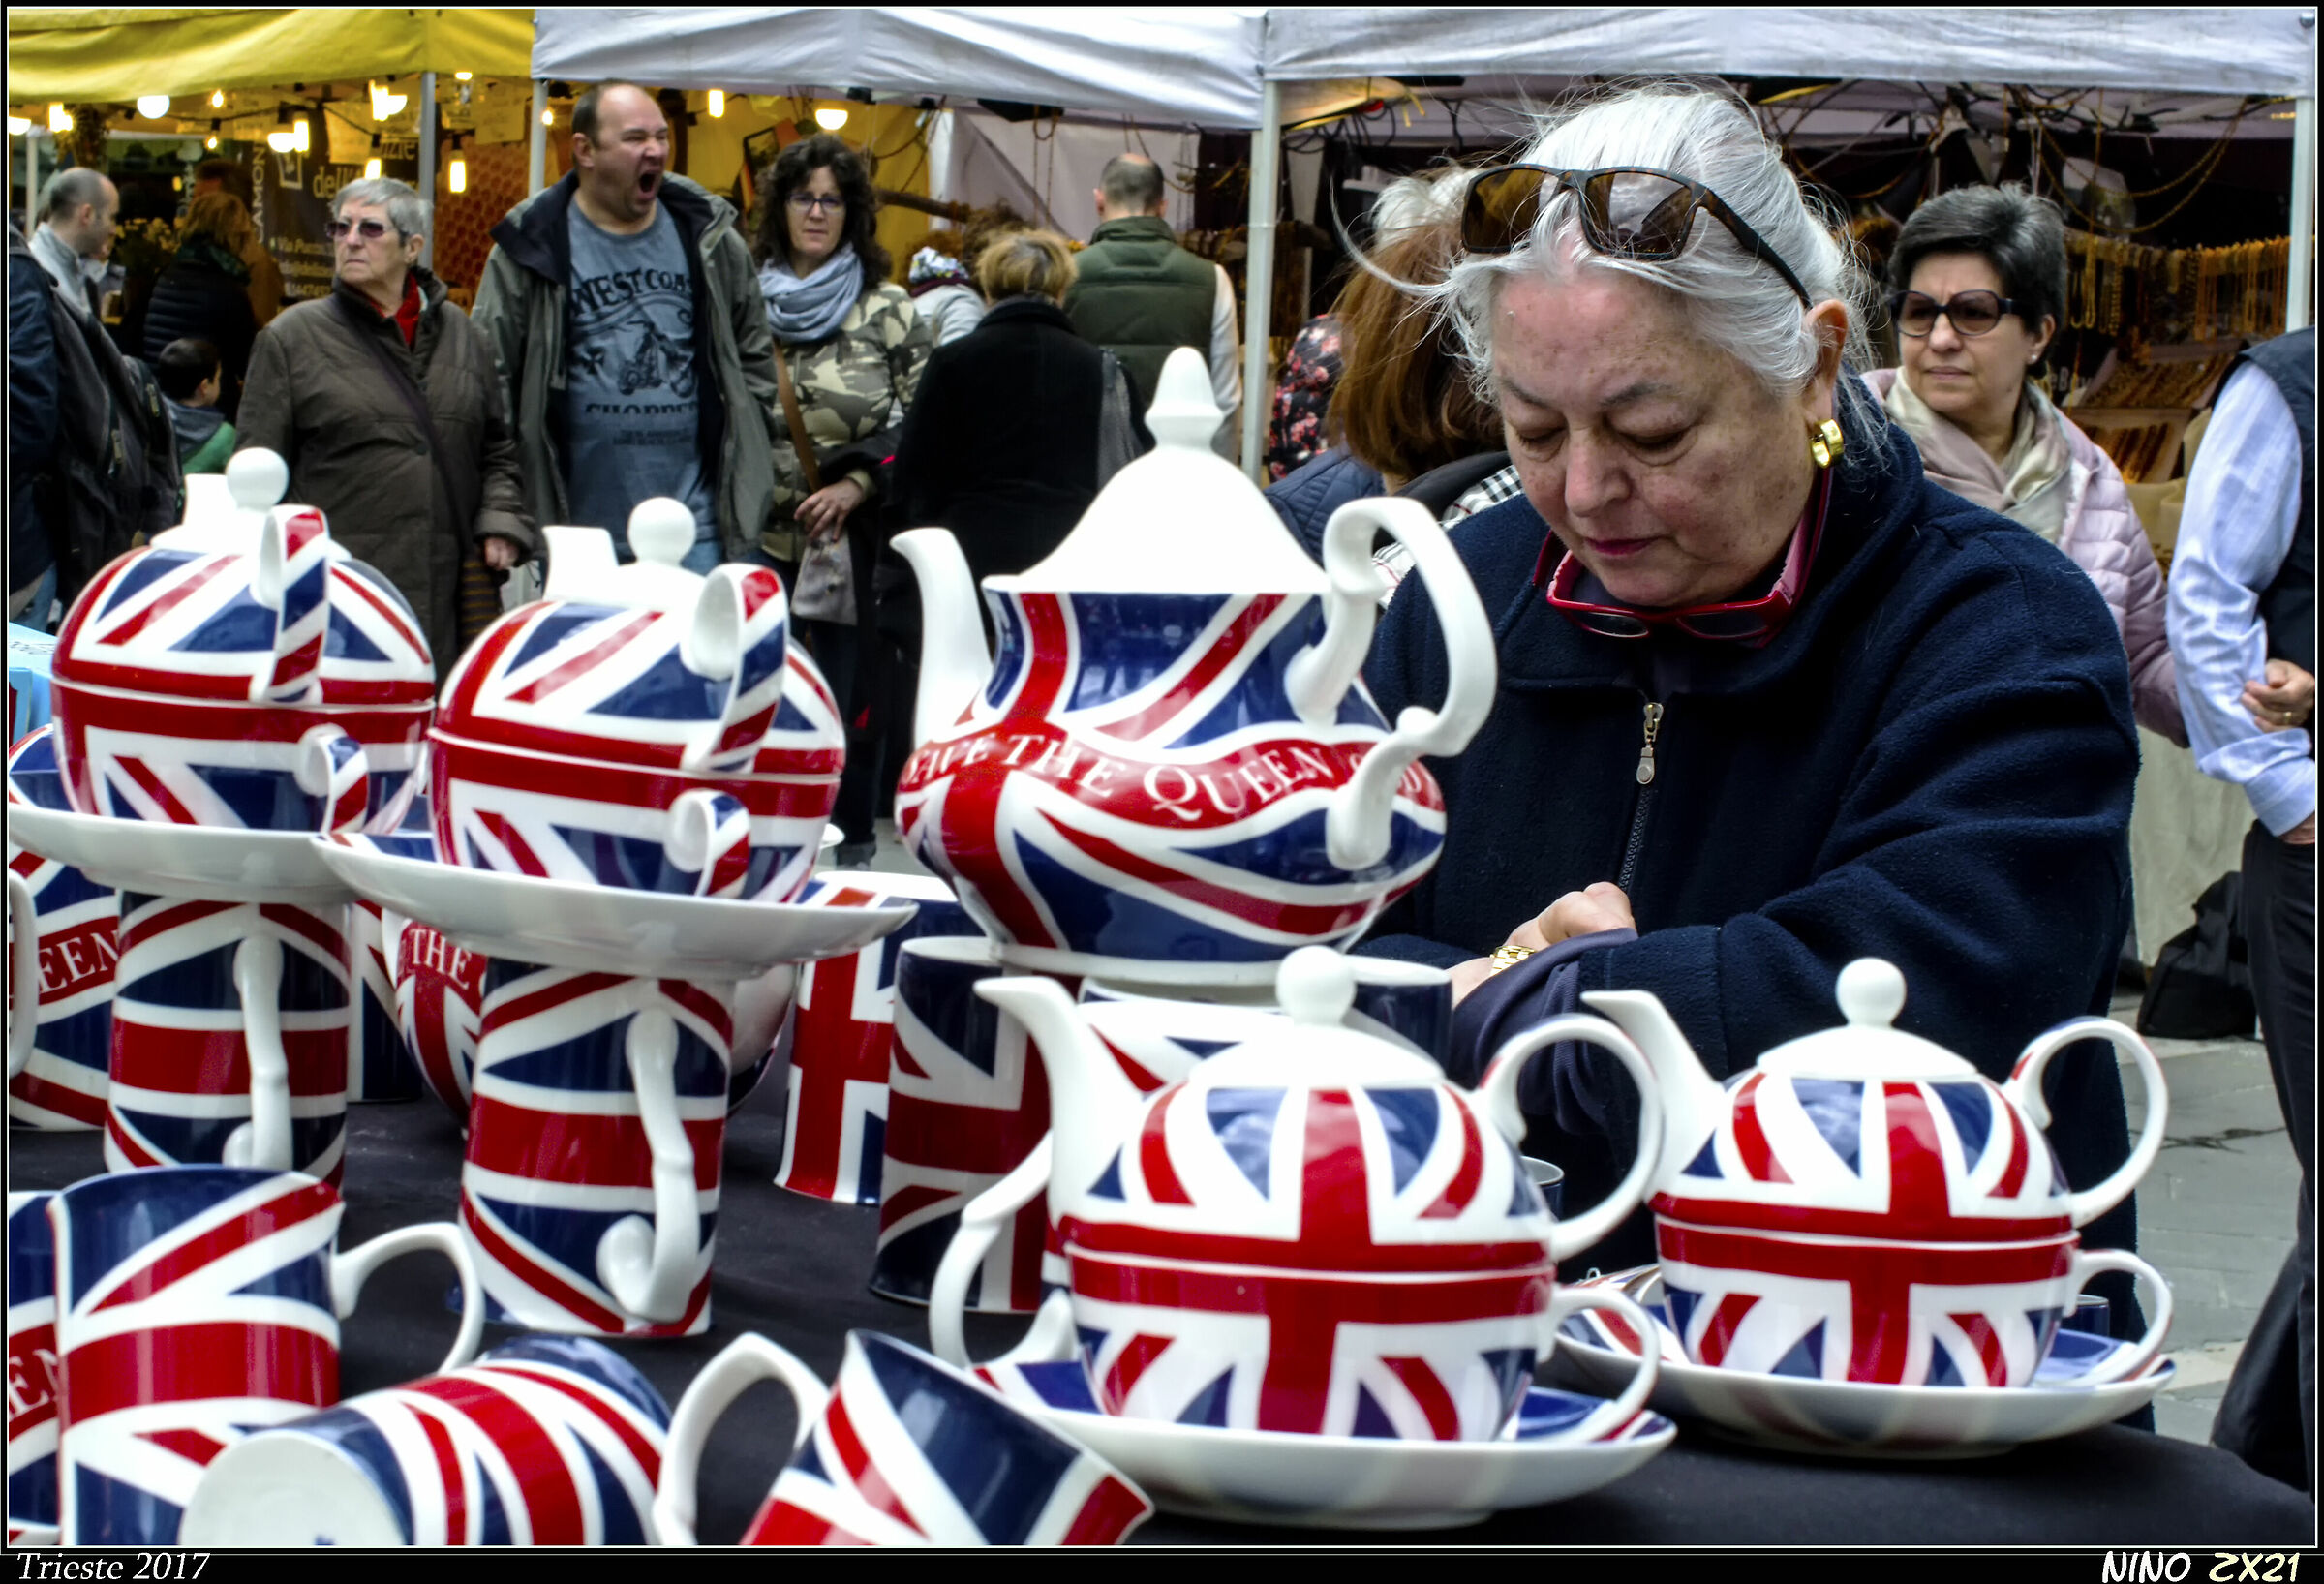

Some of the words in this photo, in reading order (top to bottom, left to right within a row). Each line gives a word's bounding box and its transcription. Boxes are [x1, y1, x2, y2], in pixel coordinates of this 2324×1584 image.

[571, 267, 642, 317] WEST
[645, 268, 690, 294] COA
[1001, 734, 1126, 798] THE
[1143, 747, 1334, 821] QUEEN
[38, 929, 120, 995] EEN
[409, 929, 472, 990] THE
